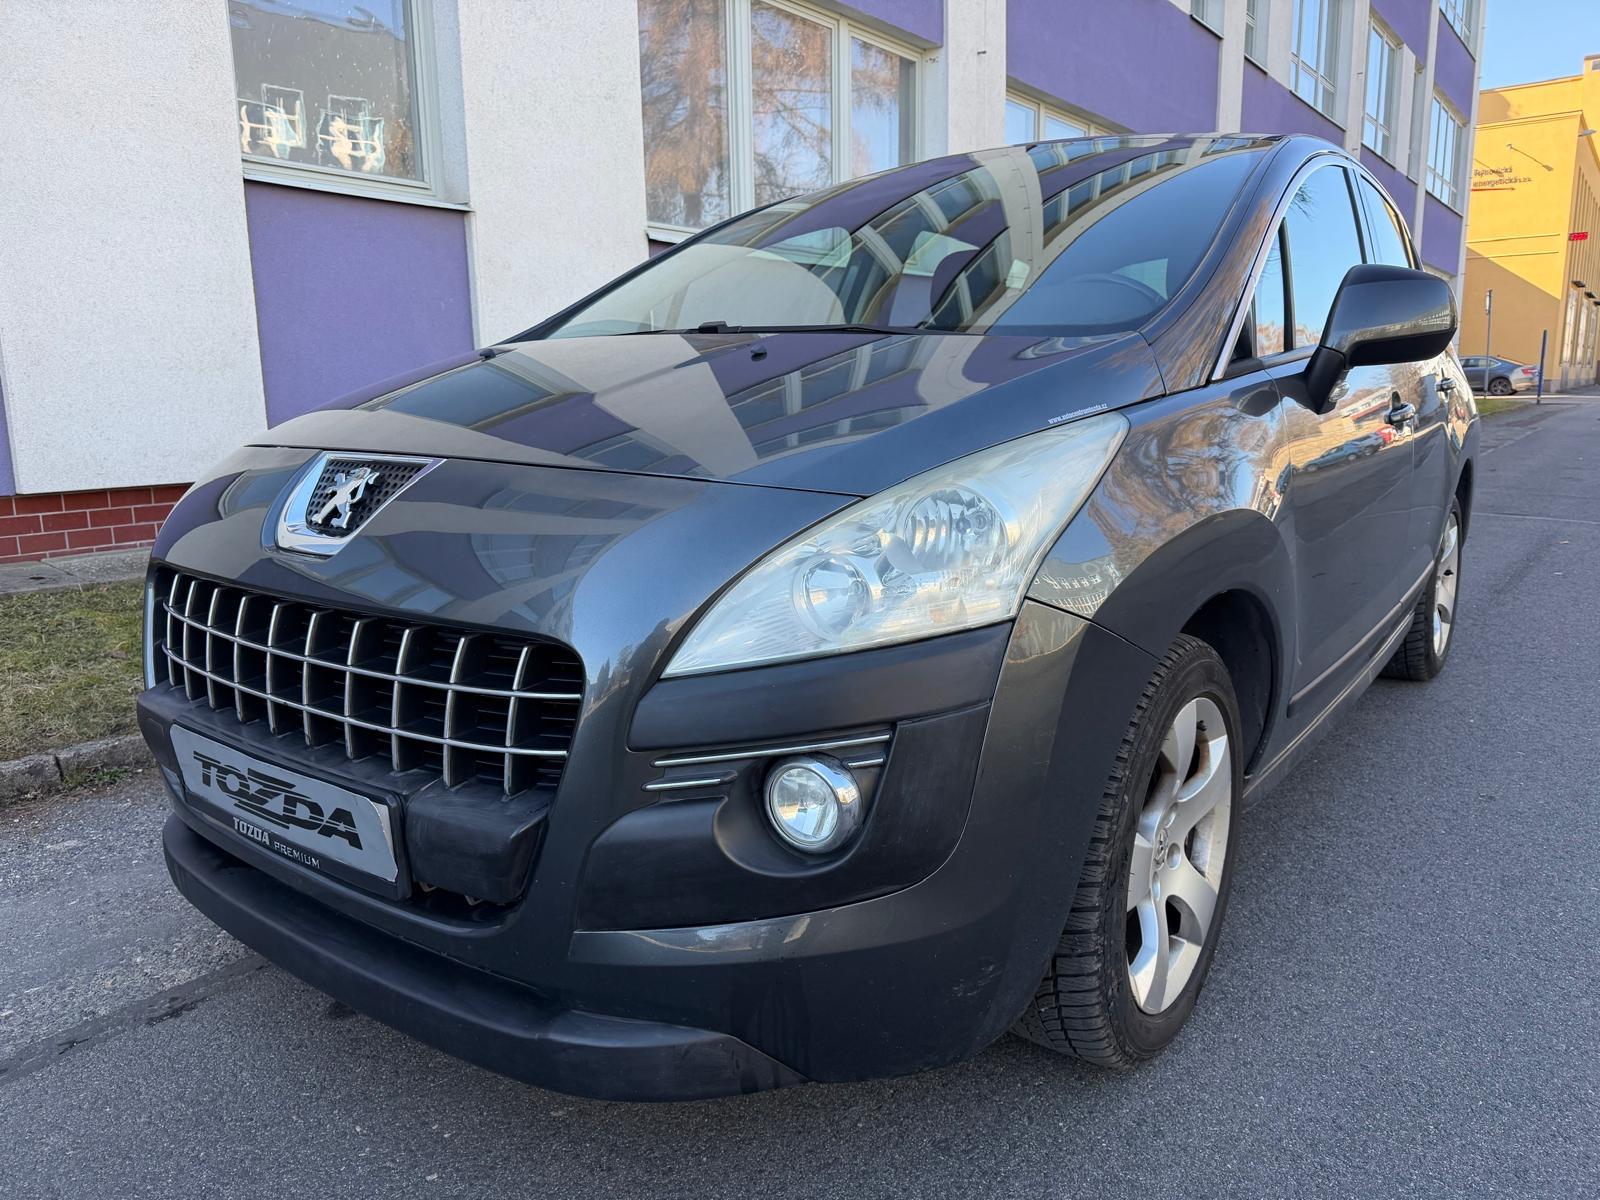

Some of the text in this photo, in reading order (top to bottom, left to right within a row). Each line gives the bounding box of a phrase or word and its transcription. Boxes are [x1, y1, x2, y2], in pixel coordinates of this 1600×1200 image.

[193, 750, 363, 850] TOZDA
[232, 816, 321, 869] TOZDA PREMIUM
